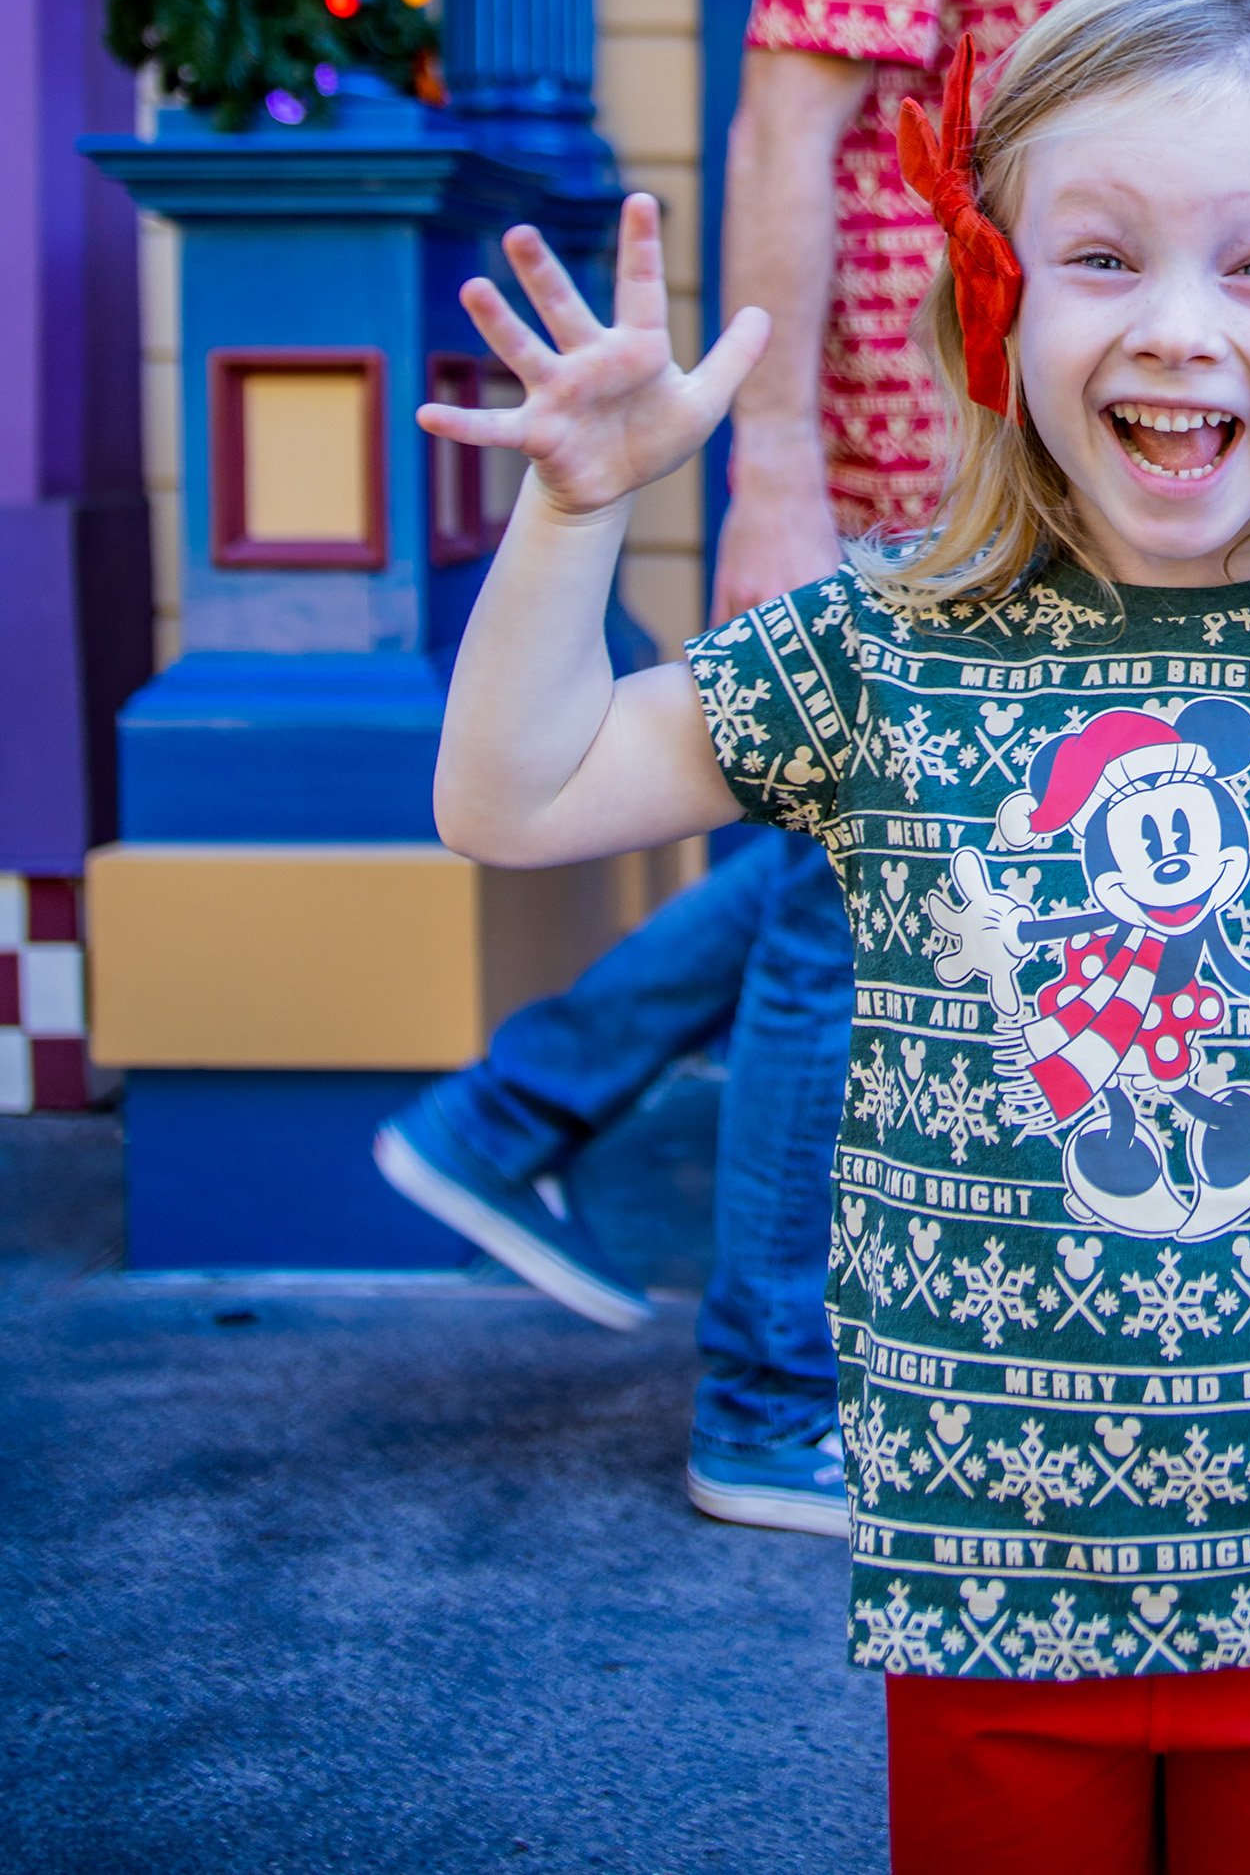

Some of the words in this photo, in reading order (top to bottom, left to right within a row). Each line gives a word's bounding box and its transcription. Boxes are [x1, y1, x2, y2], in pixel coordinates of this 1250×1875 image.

[758, 597, 803, 657] ERRY
[791, 669, 841, 740] AND
[960, 663, 1067, 691] MERRY
[1081, 660, 1153, 687] AND
[886, 819, 966, 849] MERRY
[856, 990, 917, 1023] MERRY
[928, 999, 979, 1031] AND
[925, 1177, 1032, 1216] BRIGHT
[1004, 1366, 1117, 1402] MERRY
[1141, 1376, 1221, 1404] AND
[934, 1535, 1048, 1567] MERRY
[1065, 1543, 1140, 1574] AND
